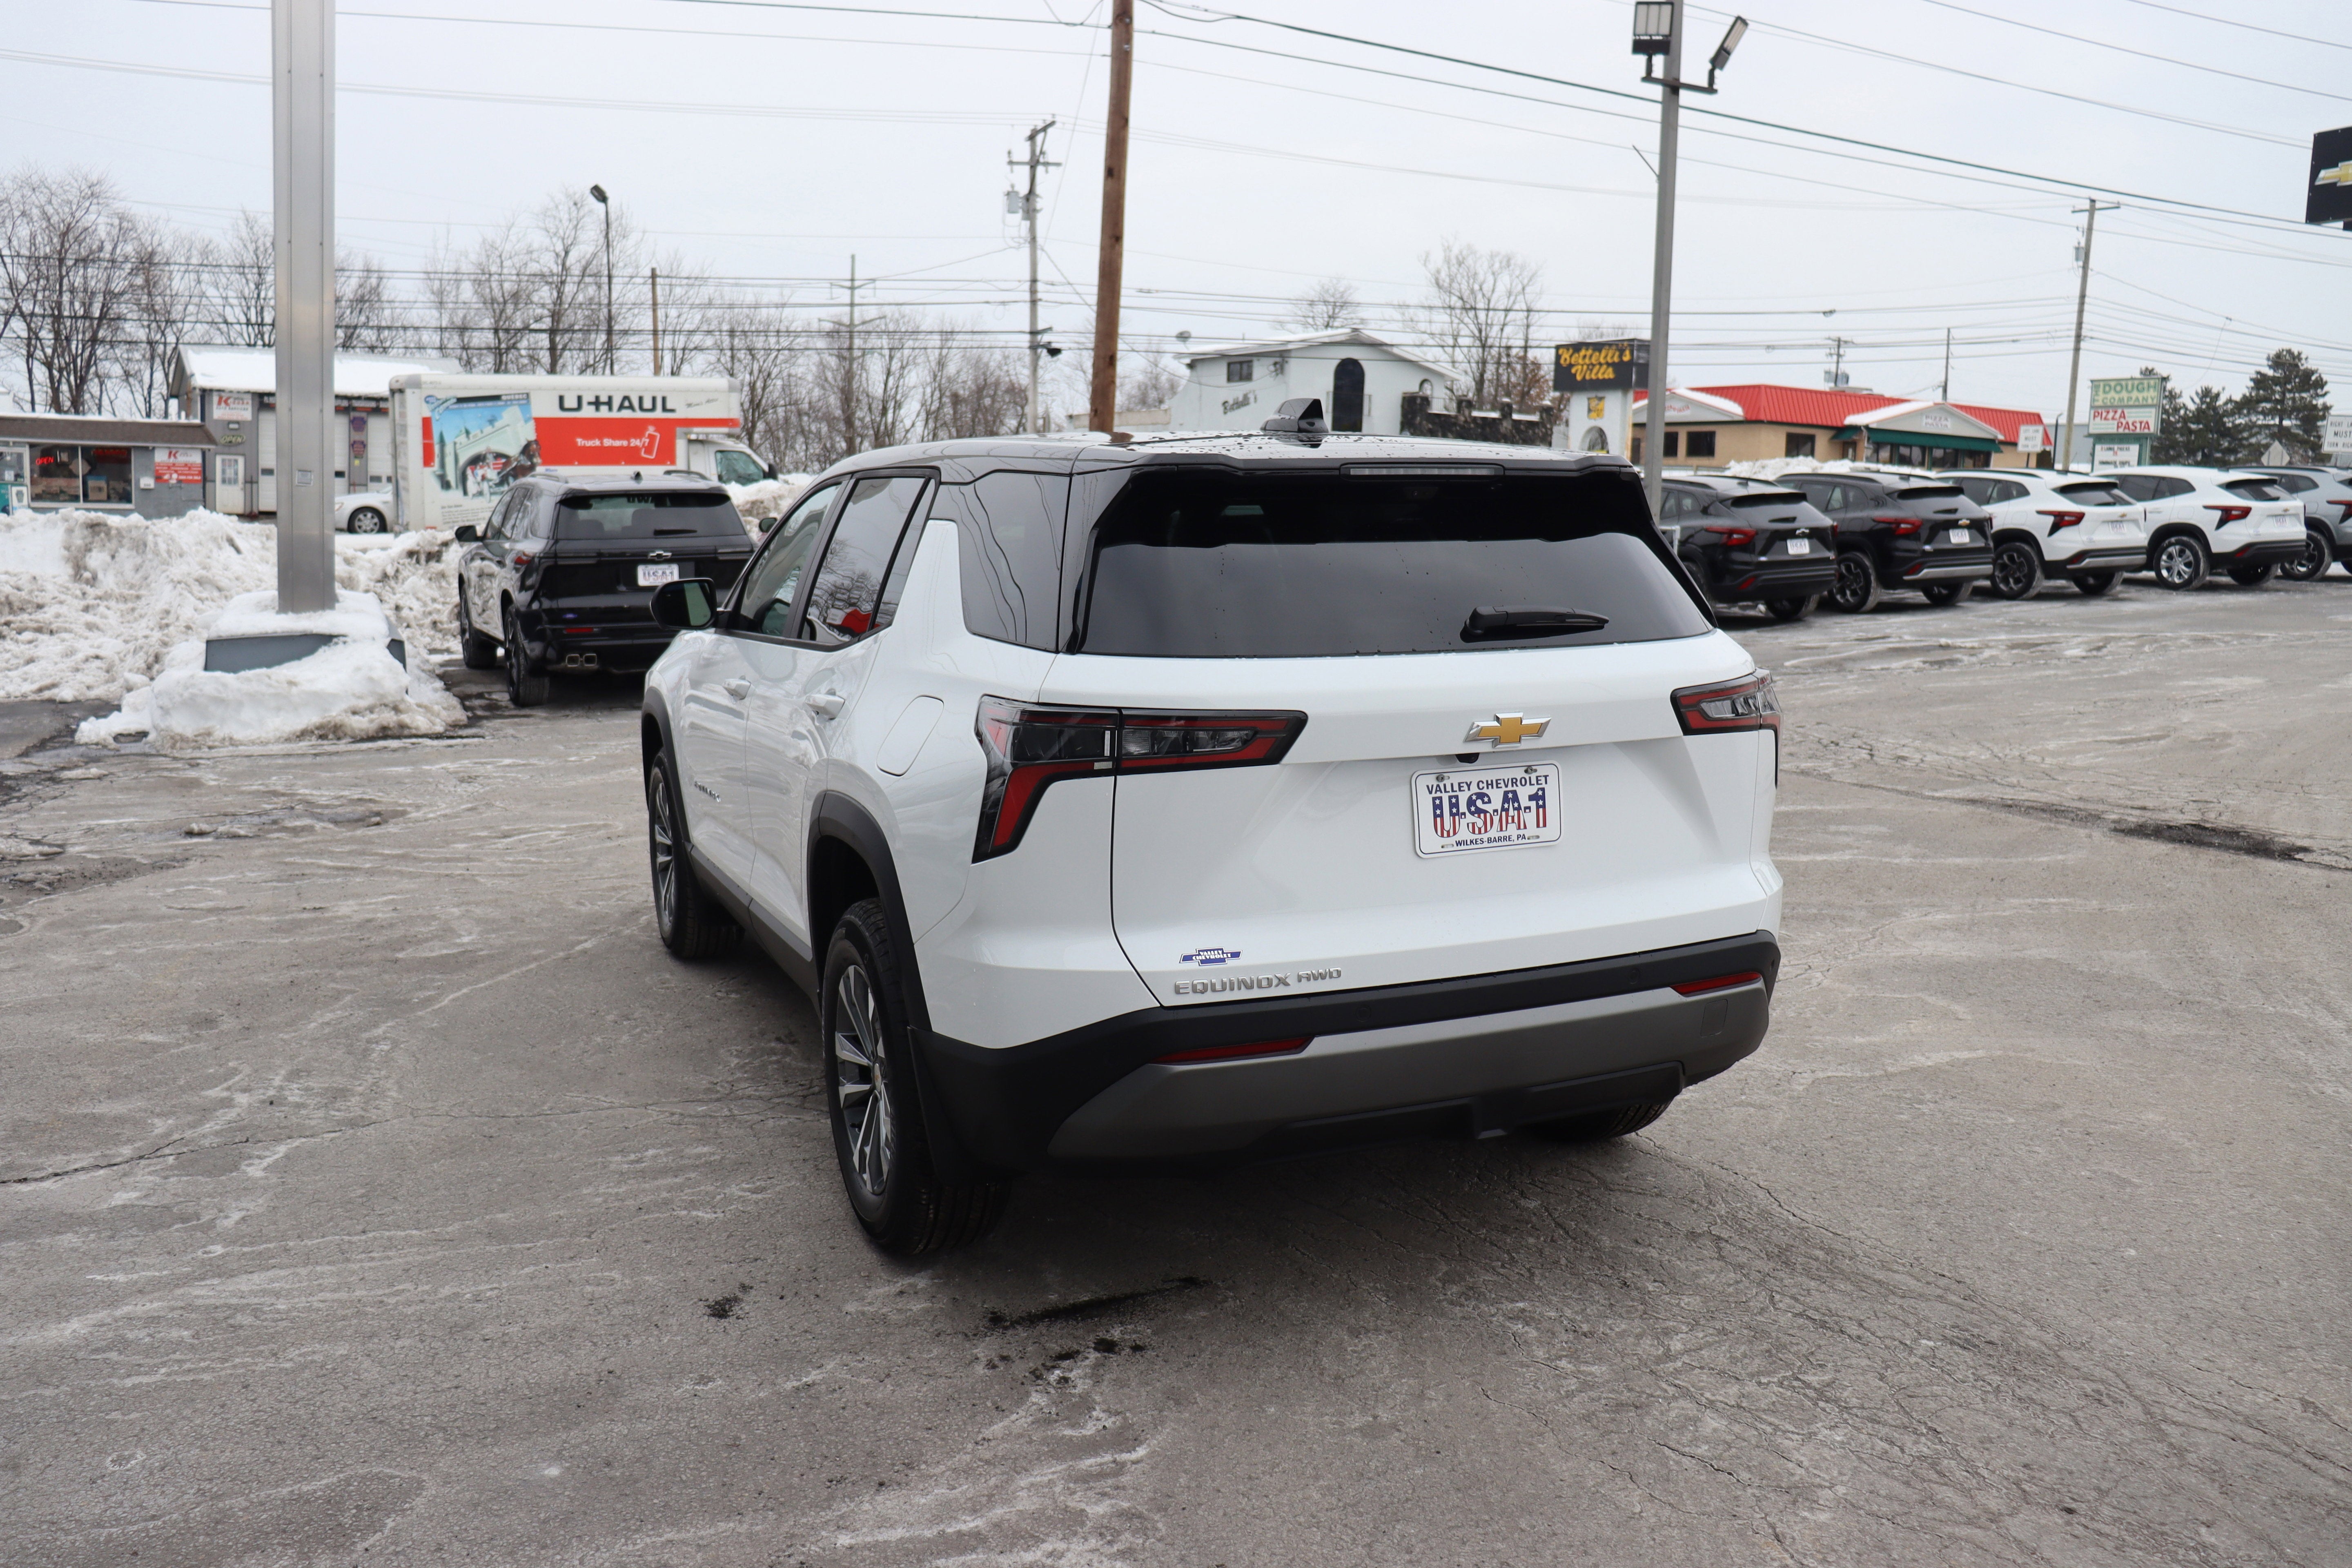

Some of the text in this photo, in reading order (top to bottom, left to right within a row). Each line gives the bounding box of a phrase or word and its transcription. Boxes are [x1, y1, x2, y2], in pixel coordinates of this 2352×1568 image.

[1558, 341, 1632, 367] Bettelli's
[1571, 364, 1616, 381] Villa
[2103, 381, 2157, 394] DOUGH
[2102, 396, 2156, 405] COMPANY
[2093, 408, 2126, 421] PIZZA
[2116, 420, 2151, 432] PASTA
[2334, 430, 2352, 438] MUST
[576, 437, 650, 448] Truck Share 24/7
[36, 456, 54, 466] OPEN
[1426, 775, 1549, 795] VALLEY CHEVROLET
[1455, 835, 1515, 847] WILKES-BARRE,
[1174, 967, 1342, 994] EQUINOX AWD
